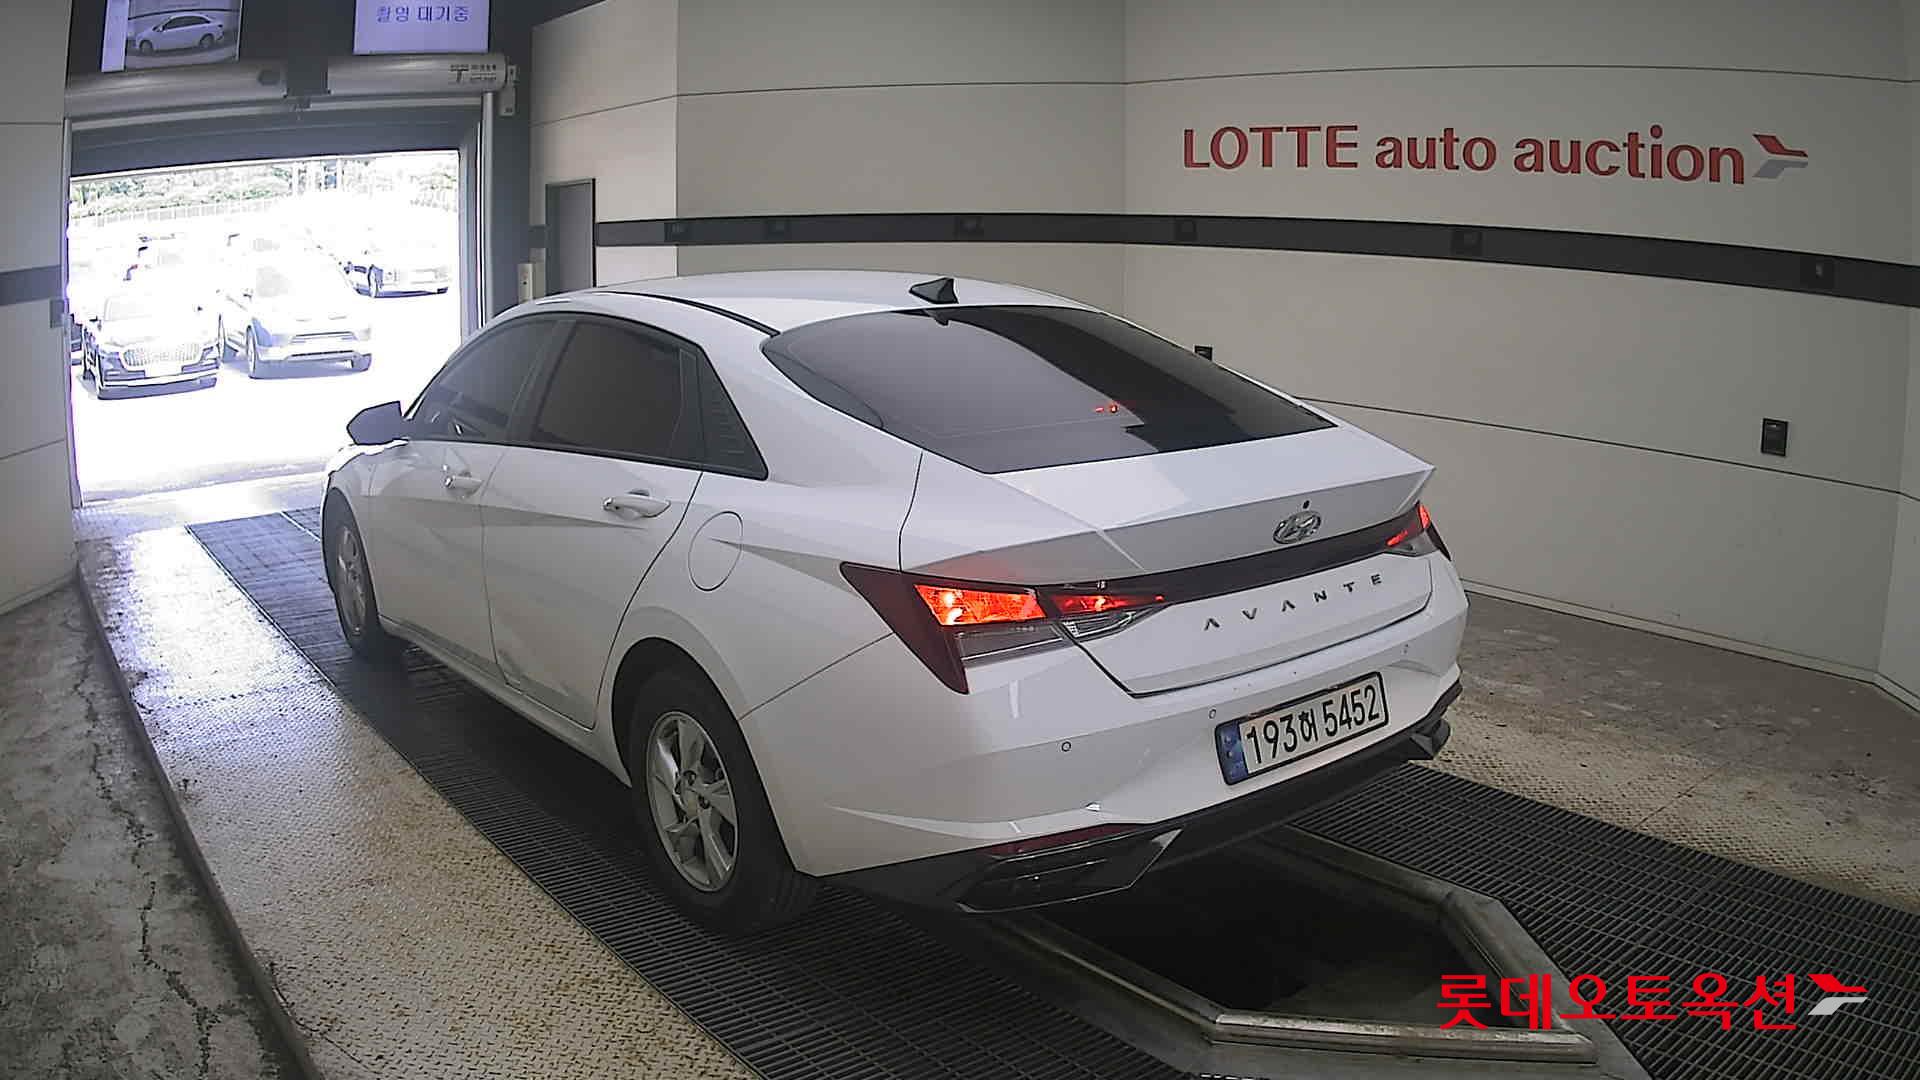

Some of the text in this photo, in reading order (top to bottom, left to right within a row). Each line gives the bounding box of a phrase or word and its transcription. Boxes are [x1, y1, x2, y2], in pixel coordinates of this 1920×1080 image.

[418, 5, 468, 22] 대기중
[1183, 124, 1745, 185] LOTTE auto auction
[1204, 573, 1382, 631] AVANTE
